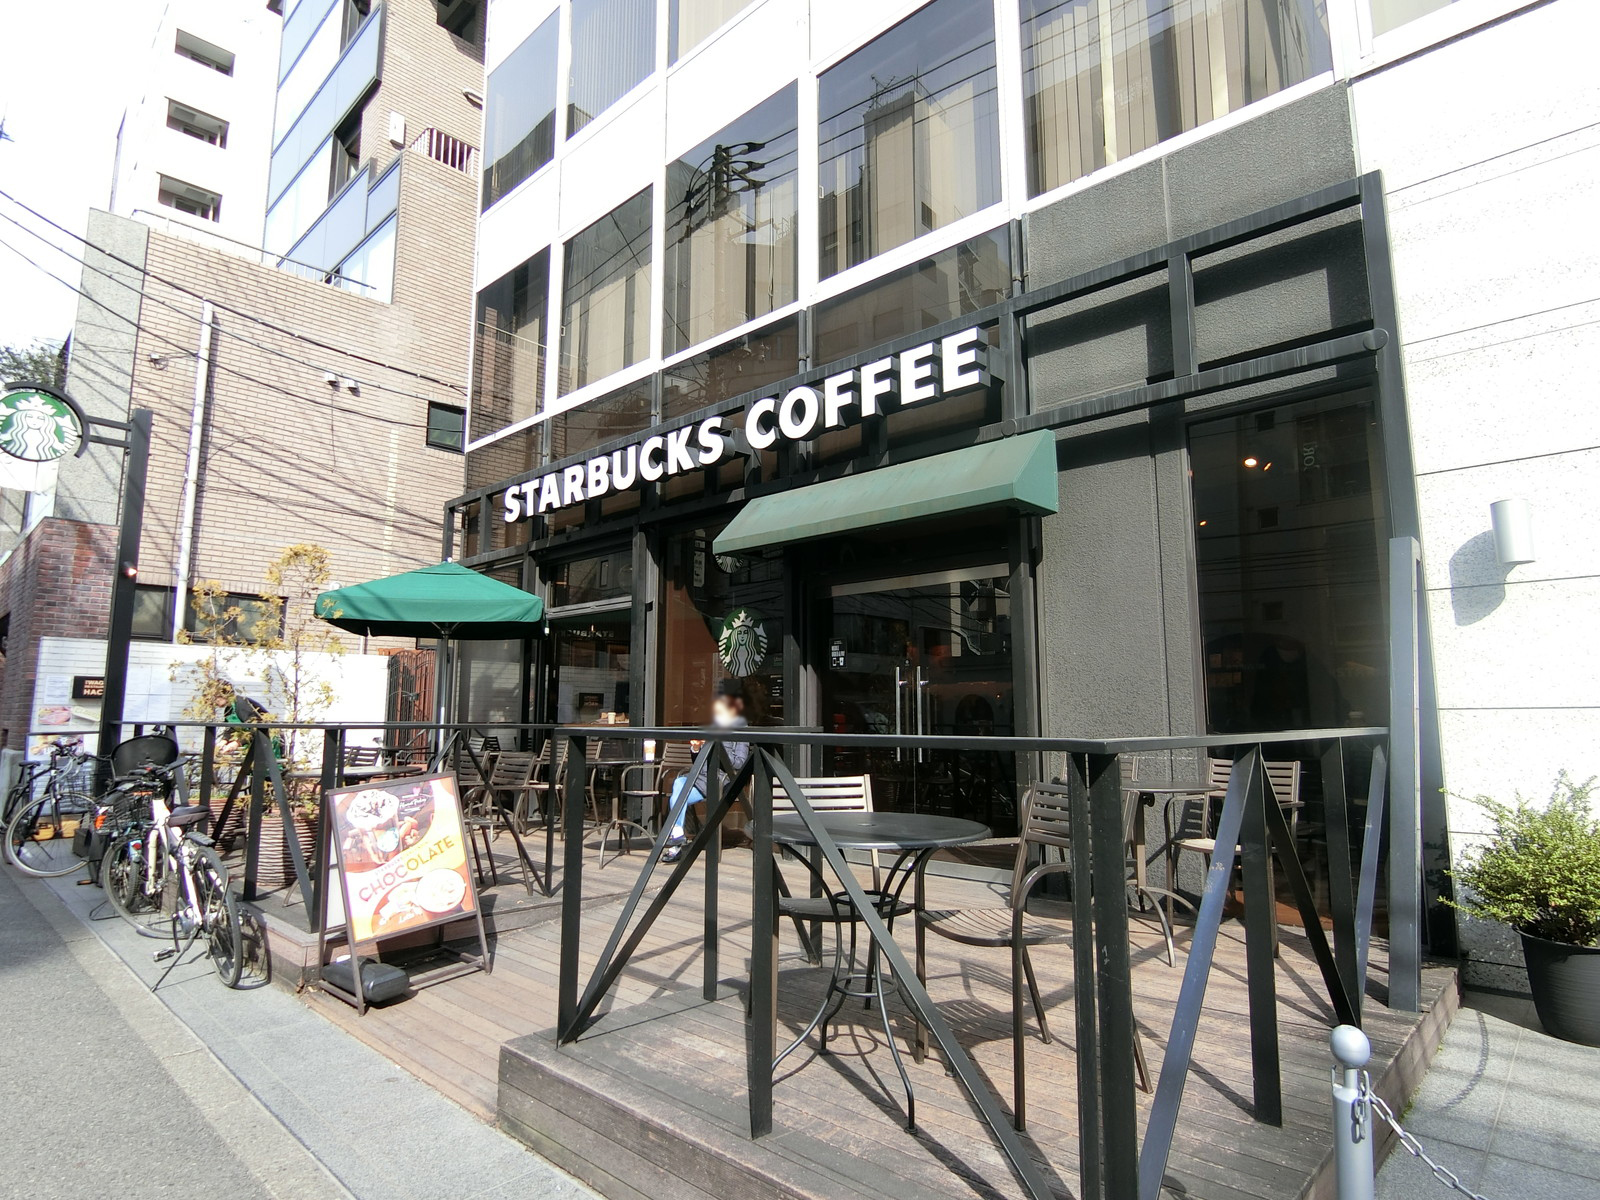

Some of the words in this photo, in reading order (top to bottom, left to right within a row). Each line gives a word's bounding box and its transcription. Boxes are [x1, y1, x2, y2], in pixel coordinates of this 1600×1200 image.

[504, 416, 729, 524] STARBUCKS
[744, 327, 984, 451] COFFEE
[358, 835, 455, 902] CHOCOLATE
